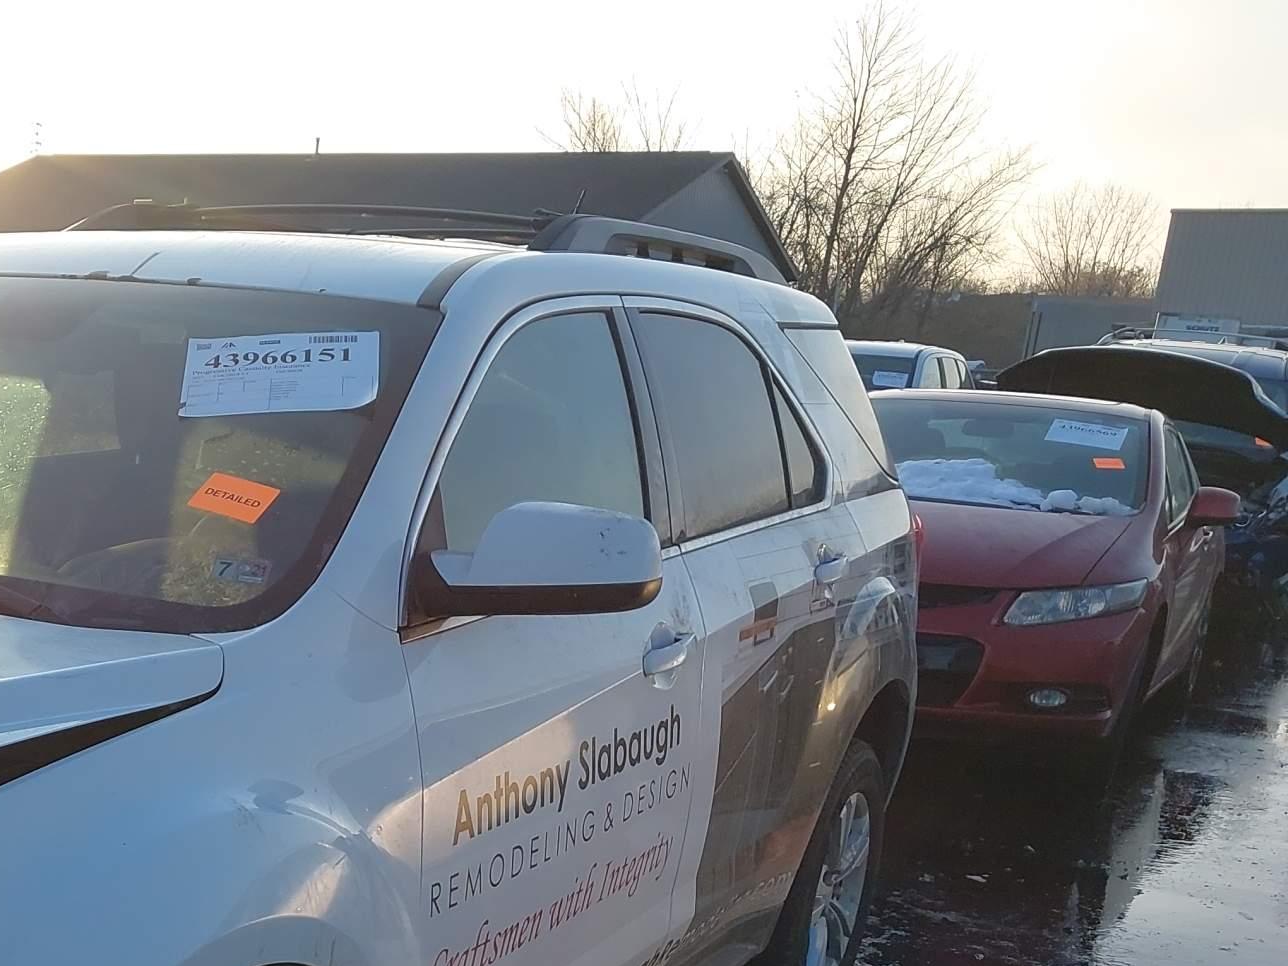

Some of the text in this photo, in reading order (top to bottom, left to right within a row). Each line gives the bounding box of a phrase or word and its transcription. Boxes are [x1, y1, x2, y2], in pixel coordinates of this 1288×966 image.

[204, 347, 353, 369] 43966151
[204, 487, 261, 508] DETAILED
[218, 561, 232, 577] 7
[453, 704, 681, 846] Anthony Slabaugh
[429, 762, 690, 917] REMODELING & DESIGN
[549, 863, 595, 930] with
[597, 831, 674, 903] Integrity
